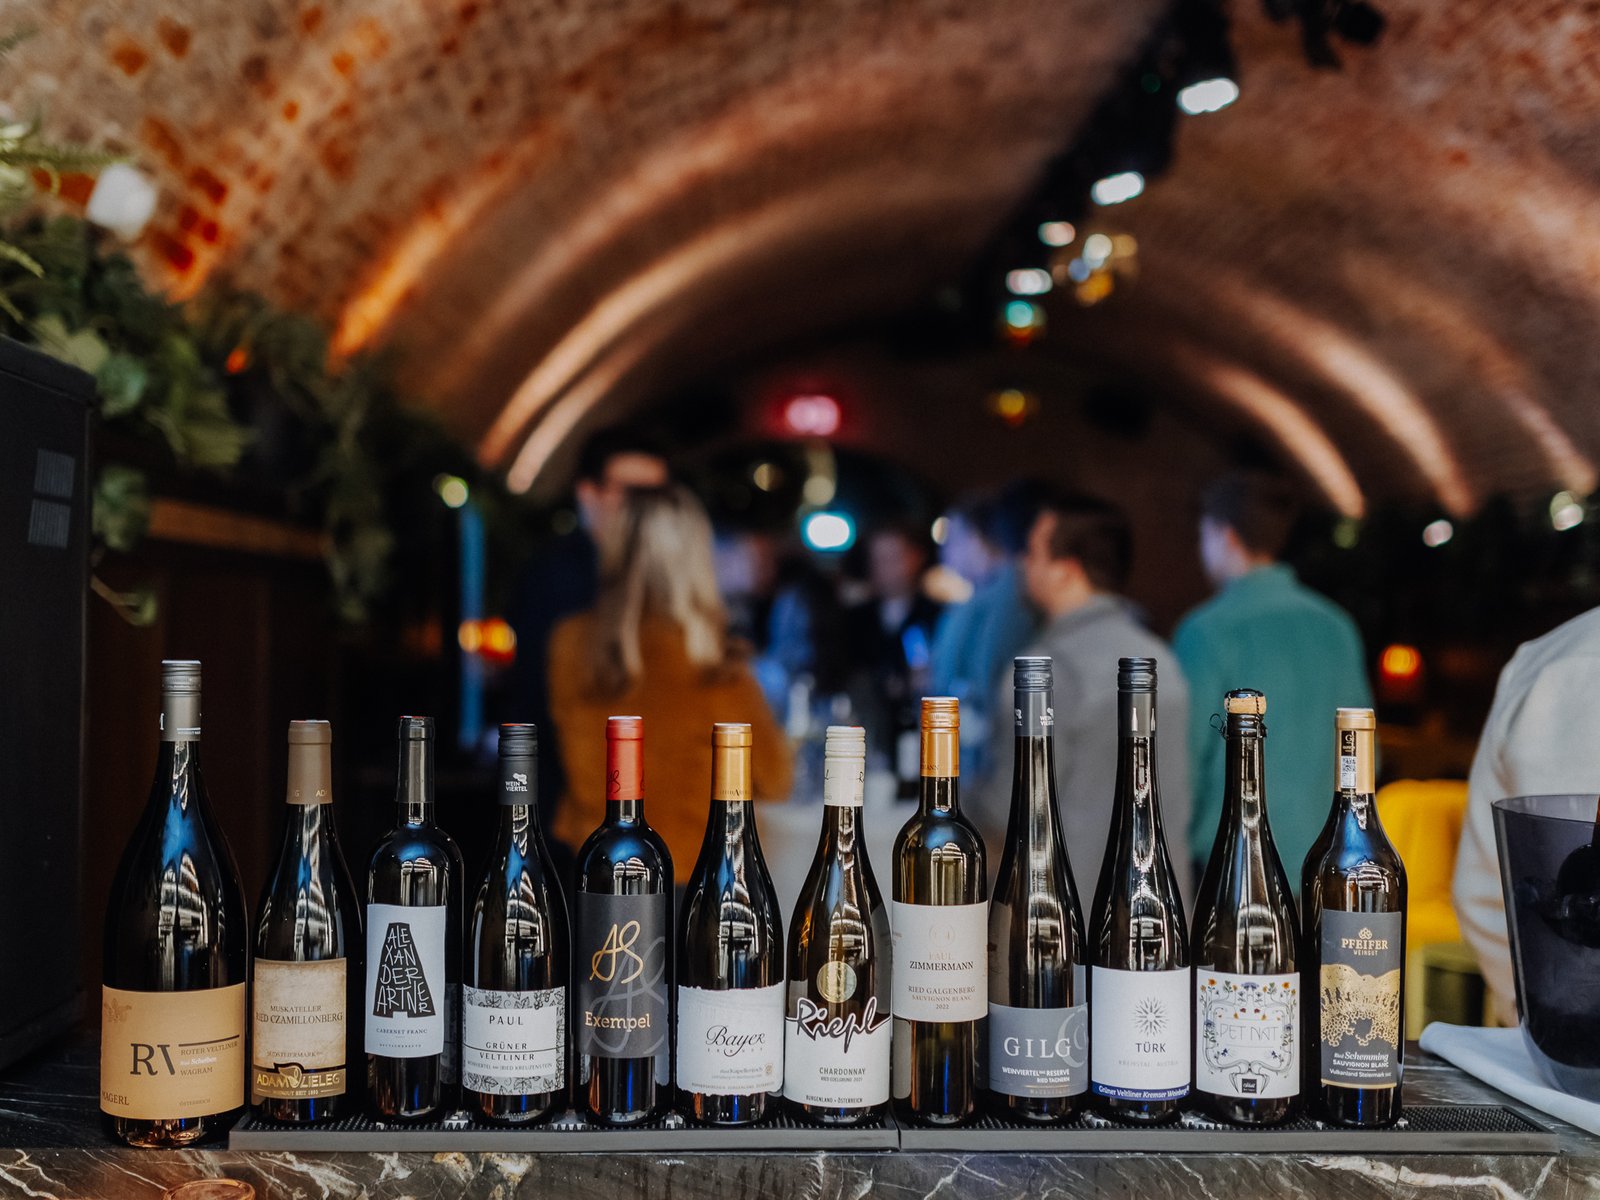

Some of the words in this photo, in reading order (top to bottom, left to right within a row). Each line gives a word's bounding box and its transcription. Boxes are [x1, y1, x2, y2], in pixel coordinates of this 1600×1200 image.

[1341, 938, 1388, 950] PFEIFER
[909, 960, 974, 971] ZIMMERMANN
[908, 985, 925, 994] RIED
[926, 986, 975, 995] GALGENBERG
[270, 1005, 322, 1013] MUSKATELLER
[270, 1012, 343, 1025] CZAMILLONBERG
[489, 1015, 524, 1026] PAUL
[585, 1011, 651, 1032] Exempel
[794, 996, 882, 1054] Riepl
[1220, 1023, 1246, 1040] PET
[180, 1047, 205, 1056] ROTER
[206, 1041, 238, 1053] VELTLINER
[485, 1041, 528, 1050] GRÜNER
[1004, 1036, 1071, 1058] GILG
[1136, 1041, 1166, 1053] TÜRK
[479, 1052, 535, 1060] VELTLINER
[1344, 1051, 1389, 1062] Schemming
[1333, 1060, 1370, 1068] SAUVIGNON
[180, 1067, 214, 1077] WAGRAM
[819, 1067, 866, 1076] CHARDONNAY
[1002, 1066, 1040, 1076] WEINVIERTEL
[1046, 1068, 1070, 1077] RESERVE
[1098, 1086, 1116, 1096] Grüner
[1117, 1089, 1142, 1098] Veltliner
